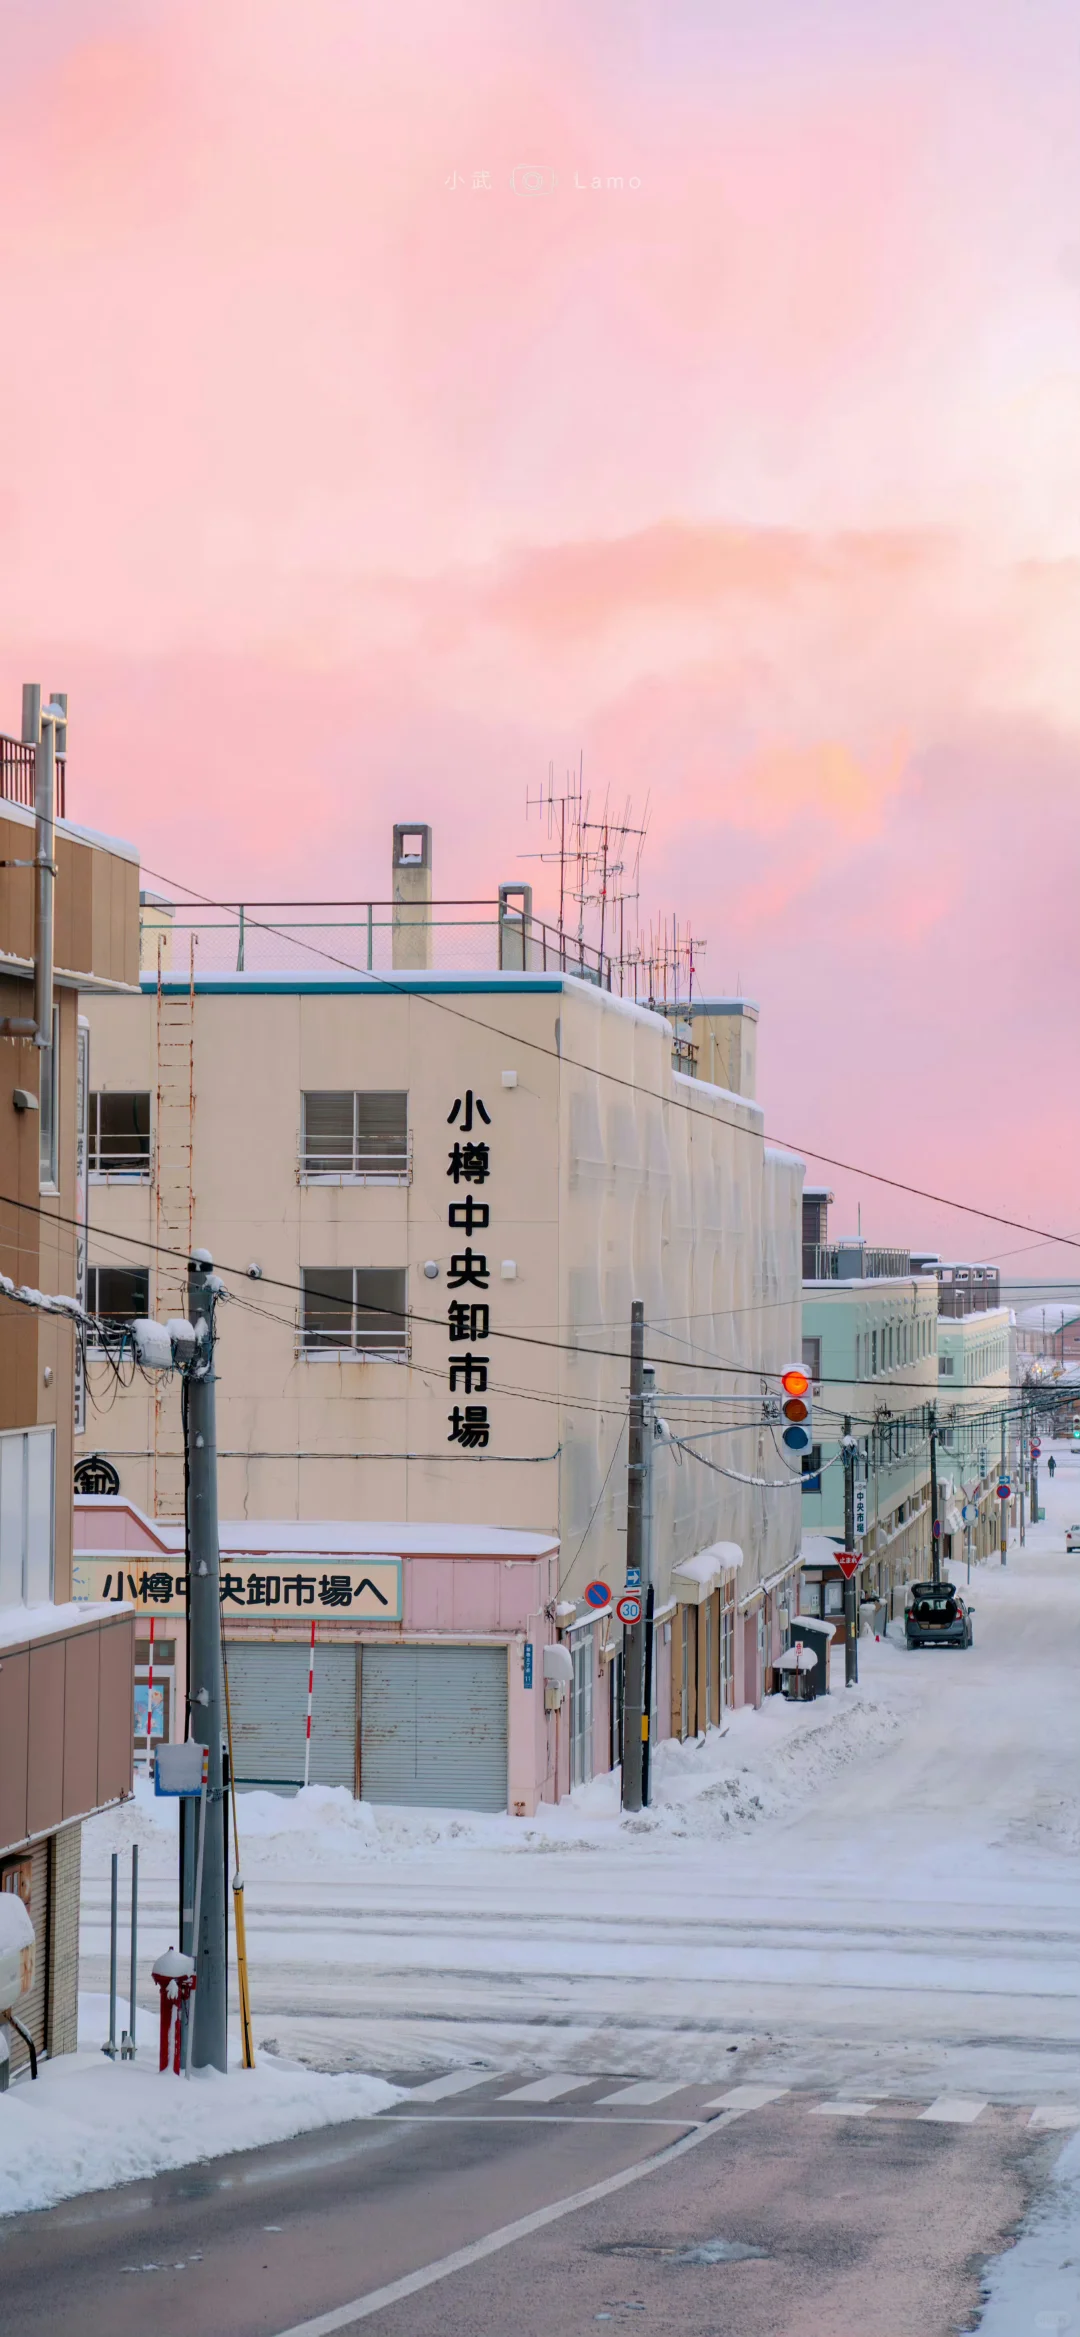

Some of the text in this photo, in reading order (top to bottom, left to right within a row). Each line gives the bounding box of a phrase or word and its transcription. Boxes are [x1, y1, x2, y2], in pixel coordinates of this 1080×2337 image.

[446, 1089, 492, 1449] 小樽中央卸市場
[857, 1492, 865, 1533] 中央市場
[622, 1604, 638, 1617] 30
